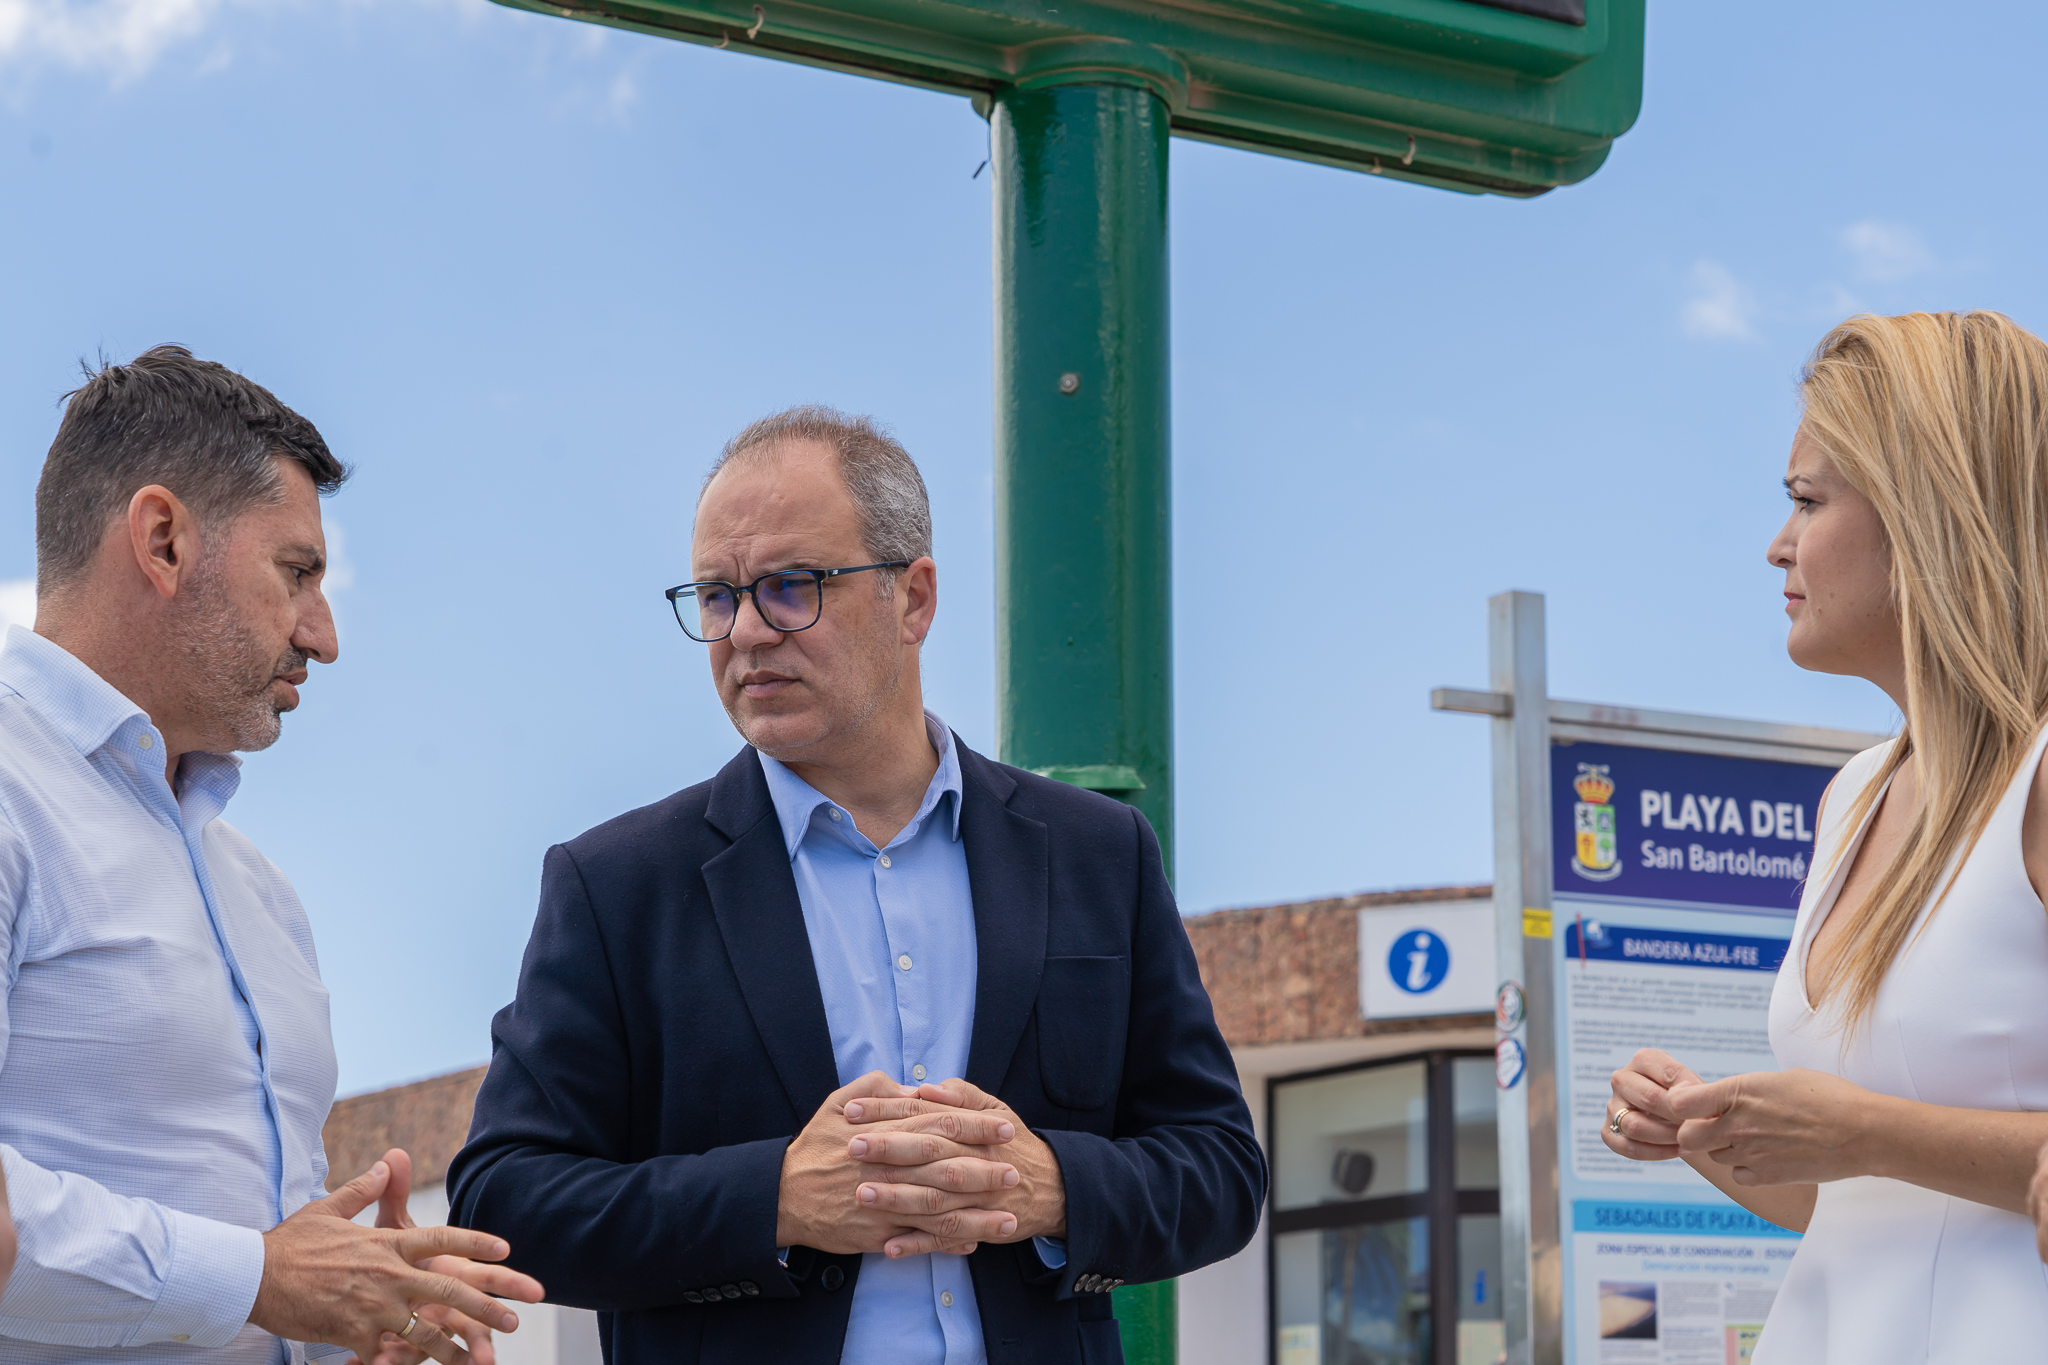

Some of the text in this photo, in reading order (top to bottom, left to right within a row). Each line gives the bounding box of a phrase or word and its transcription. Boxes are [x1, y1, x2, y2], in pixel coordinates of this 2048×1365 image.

[1640, 789, 1813, 842] PLAYA DEL
[1640, 839, 1806, 881] San Bartolomé
[1623, 938, 1692, 961] BANDERA
[1594, 1206, 1683, 1230] SEBADALES
[1684, 1208, 1706, 1231] DE
[1708, 1210, 1758, 1233] PLAYA
